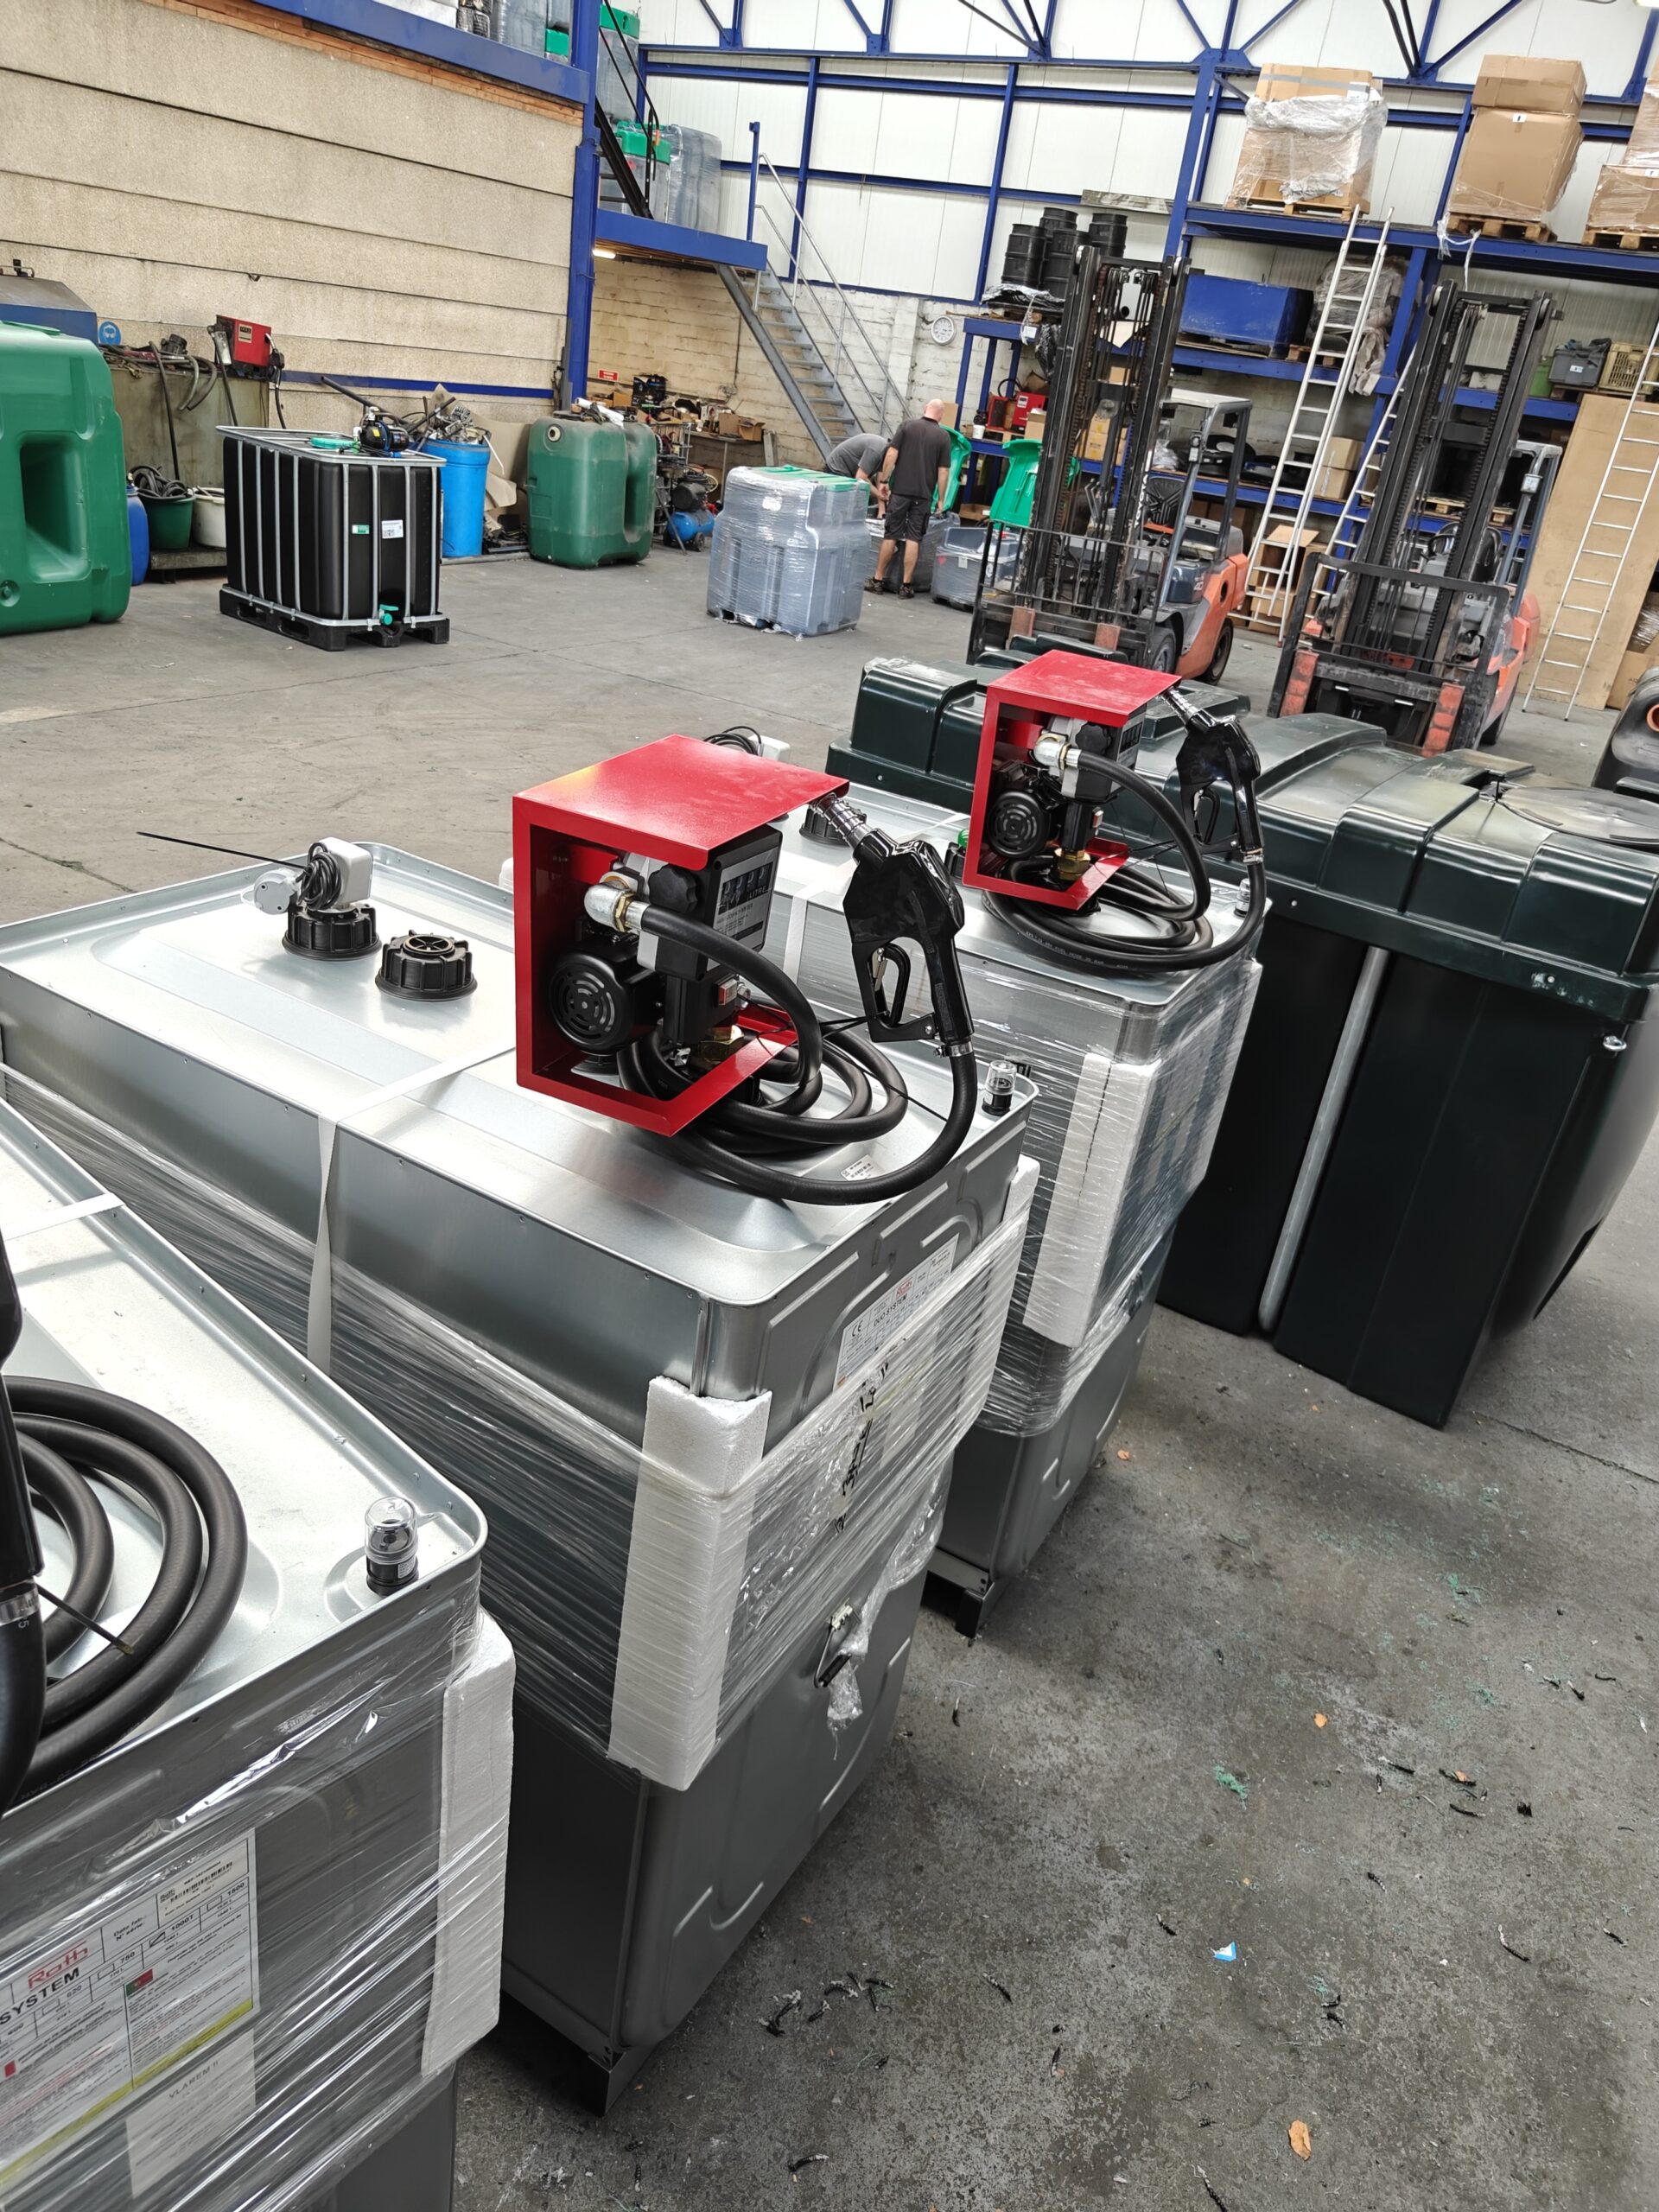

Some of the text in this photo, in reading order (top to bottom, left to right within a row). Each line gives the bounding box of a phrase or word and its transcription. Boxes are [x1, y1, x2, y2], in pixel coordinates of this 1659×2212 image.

[1134, 474, 1148, 529] TOYOTA
[886, 1294, 907, 1317] SYSTEM
[171, 1913, 195, 1931] 1000T
[28, 1946, 88, 1989] Roth
[120, 1950, 136, 1964] 750
[0, 1967, 79, 2025] SYSTEM
